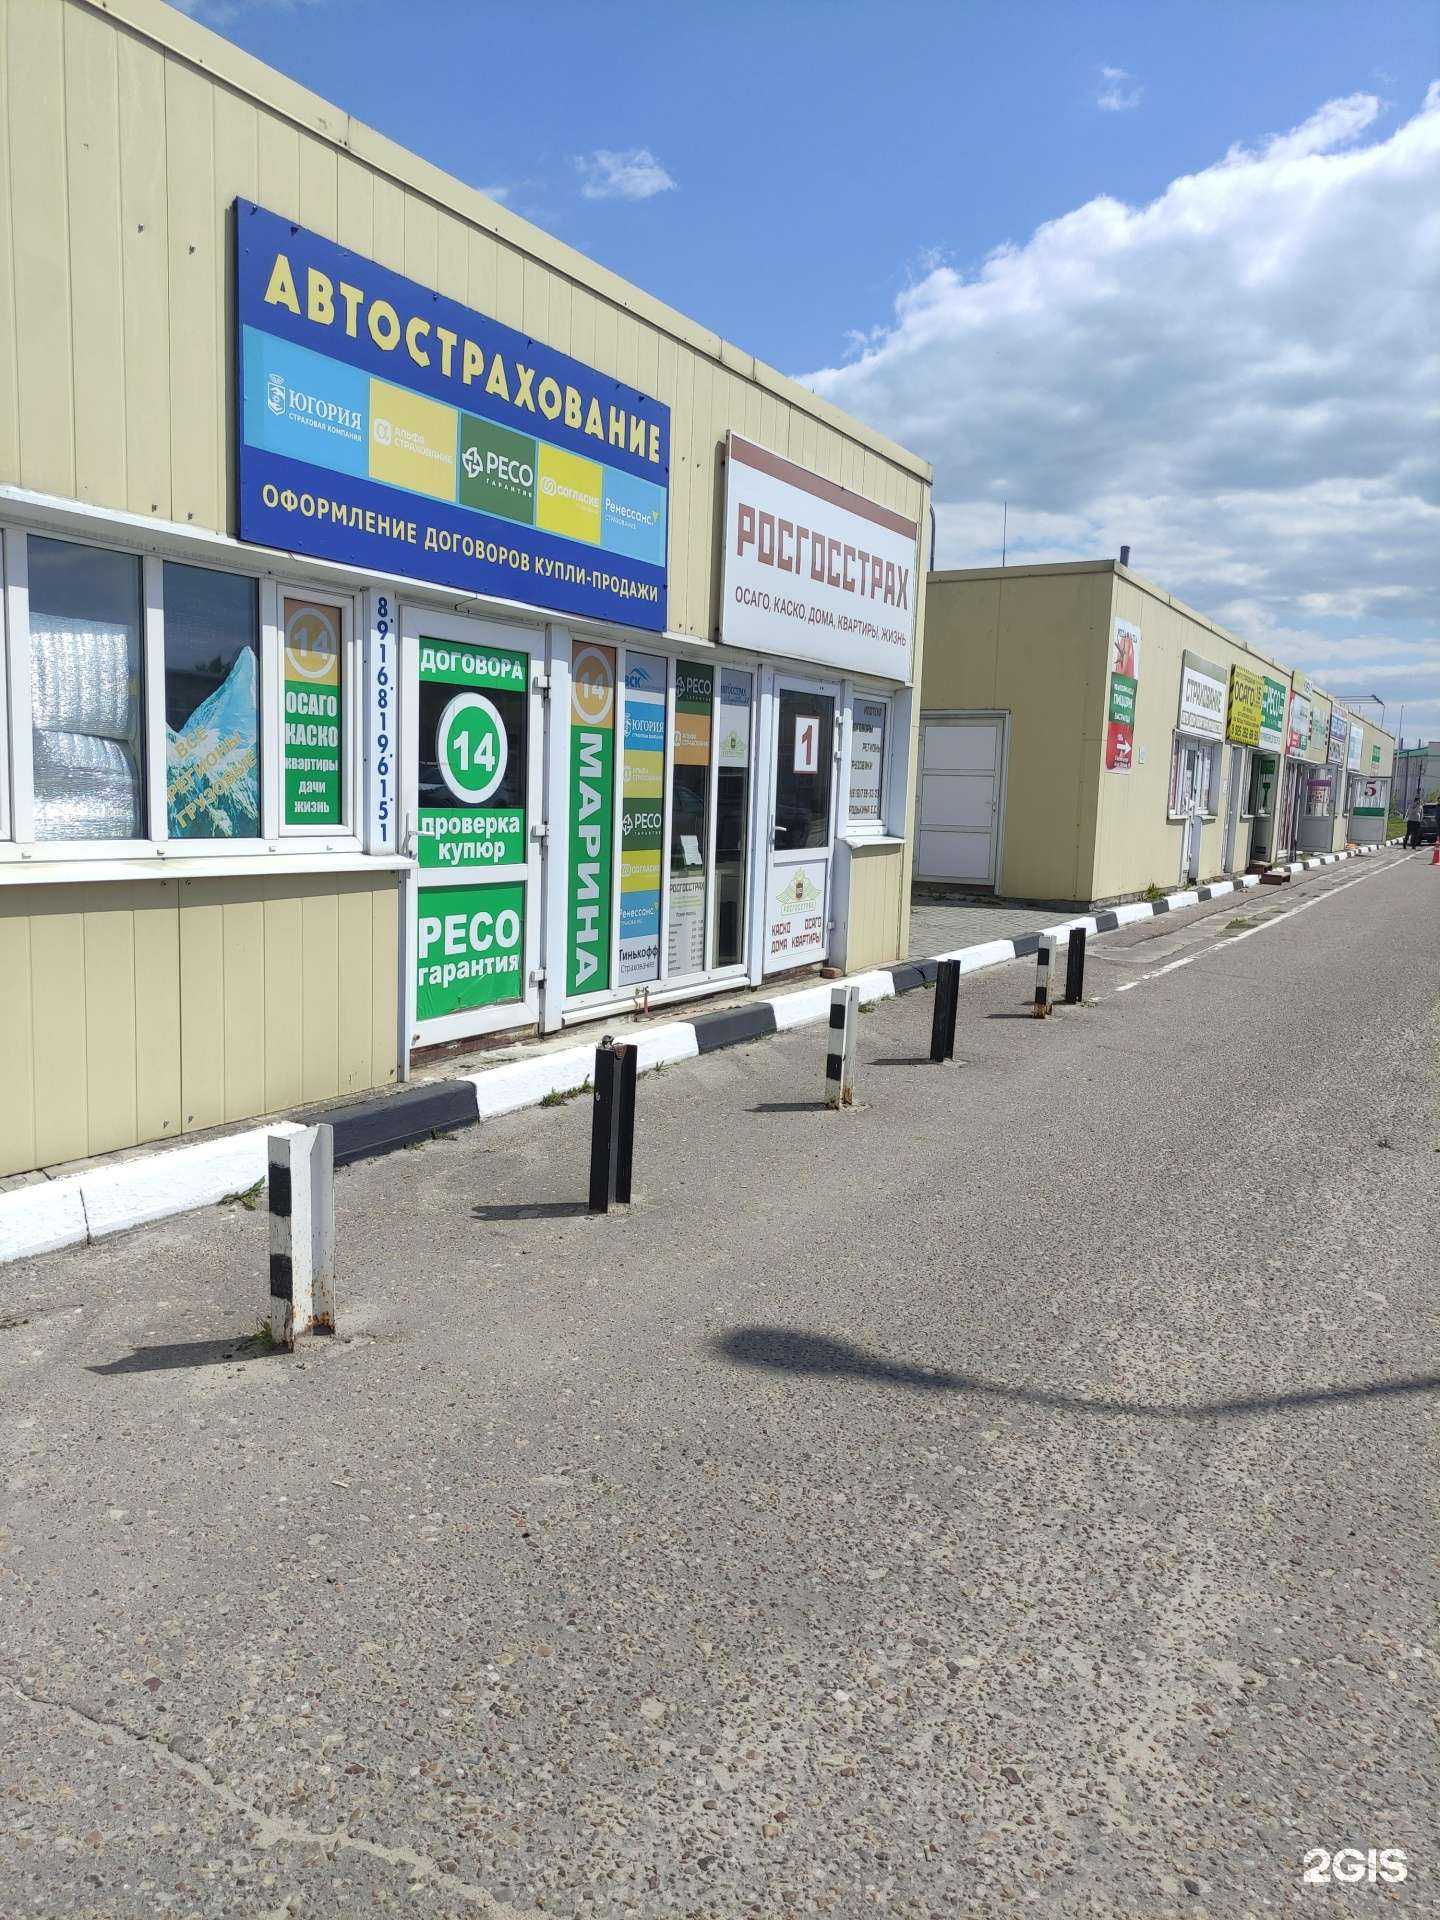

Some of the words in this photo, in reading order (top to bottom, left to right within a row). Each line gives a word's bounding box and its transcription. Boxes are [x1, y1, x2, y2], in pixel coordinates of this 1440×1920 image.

[263, 253, 661, 464] АВТОСТРАХОВАНИЕ
[289, 389, 362, 431] ЮГОРИЯ
[288, 413, 327, 431] СТРАХОВАЯ
[327, 425, 363, 442] КОМПАНИЯ
[487, 451, 534, 487] РЕСО
[262, 483, 418, 546] ОФОРМЛЕНИЕ
[424, 526, 531, 573] ДОГОВОРОВ
[535, 561, 659, 604] КУПЛИ-ПРОДАЖИ
[737, 502, 910, 611] РОСГОССТРАХ
[735, 586, 772, 613] ОСАГО,
[773, 596, 807, 622] КАСКО,
[807, 607, 836, 629] ДОМА,
[881, 628, 907, 647] ЖИЗНЬ
[294, 628, 331, 661] 14
[420, 647, 524, 680] ДОГОВОРА
[581, 671, 605, 700] 14
[686, 677, 711, 695] РЕСО
[285, 691, 338, 717] ОСАГО
[284, 723, 339, 748] КАСКО
[632, 719, 665, 732] ЮГОРИЯ
[175, 725, 209, 759] ВСЕ
[453, 730, 496, 773] 14
[801, 724, 813, 765] 1
[167, 729, 242, 802] РЕГИОНЫ
[285, 757, 338, 773] квартиры
[298, 780, 326, 794] дачи
[1364, 780, 1377, 797] 5
[294, 800, 330, 813] жизнь
[634, 814, 661, 828] РЕСО
[421, 815, 521, 840] проверка
[438, 841, 505, 865] купюр
[575, 732, 603, 988] МАРИНА
[418, 909, 521, 959] РЕСО
[771, 921, 791, 936] КАСКО
[804, 917, 822, 930] ОСАГО
[619, 945, 660, 962] Тинькофф
[770, 938, 788, 954] ДОМА
[791, 932, 822, 948] КВАРТИРЫ
[418, 954, 520, 989] гарантия
